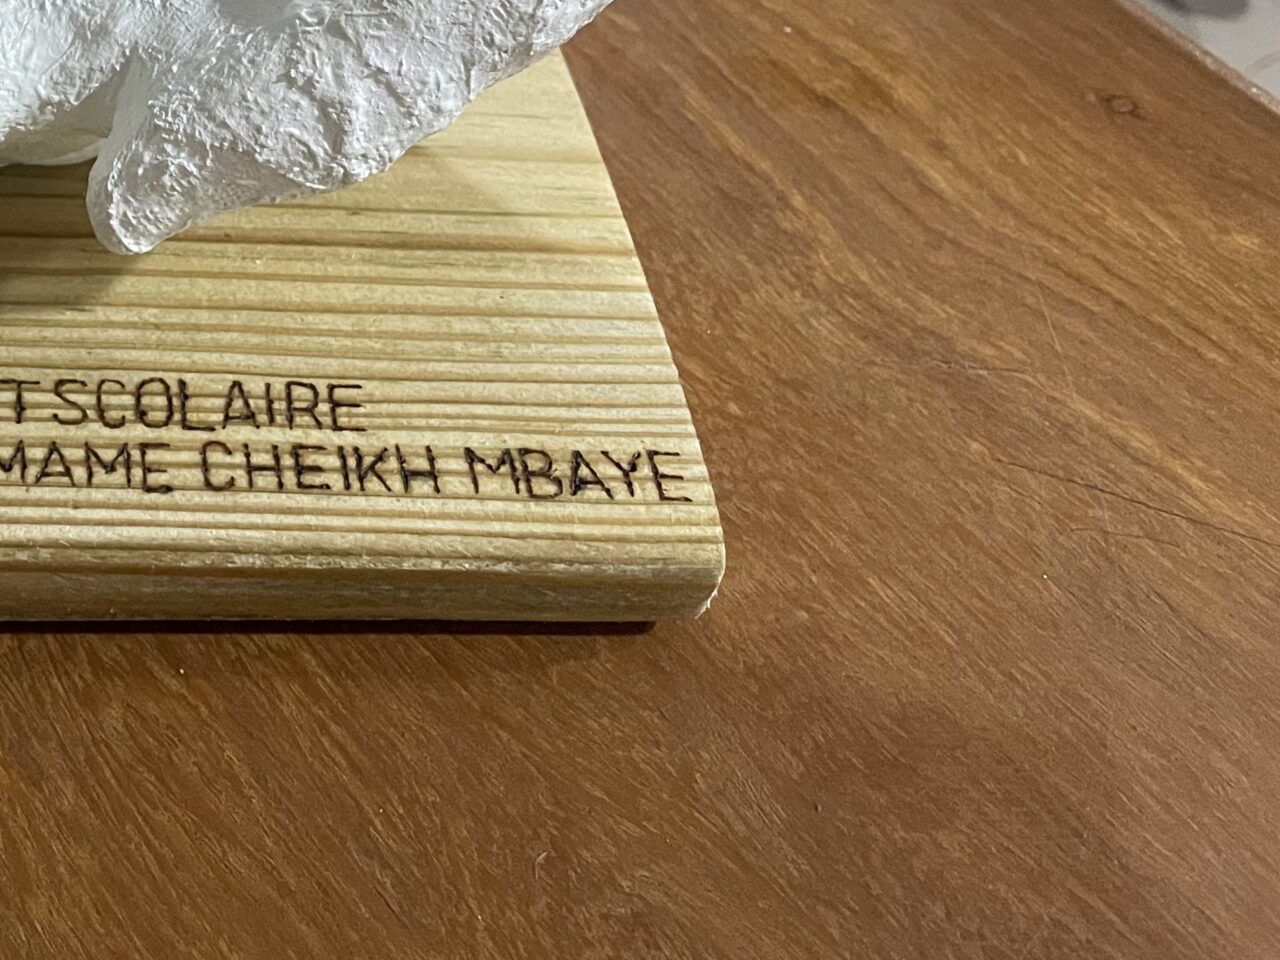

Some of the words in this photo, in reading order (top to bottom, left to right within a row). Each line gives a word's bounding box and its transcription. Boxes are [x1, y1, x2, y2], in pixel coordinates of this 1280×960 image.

[51, 377, 368, 432] SCOLAIRE
[200, 440, 441, 494] CHEIKH
[462, 445, 694, 503] MBAYE
